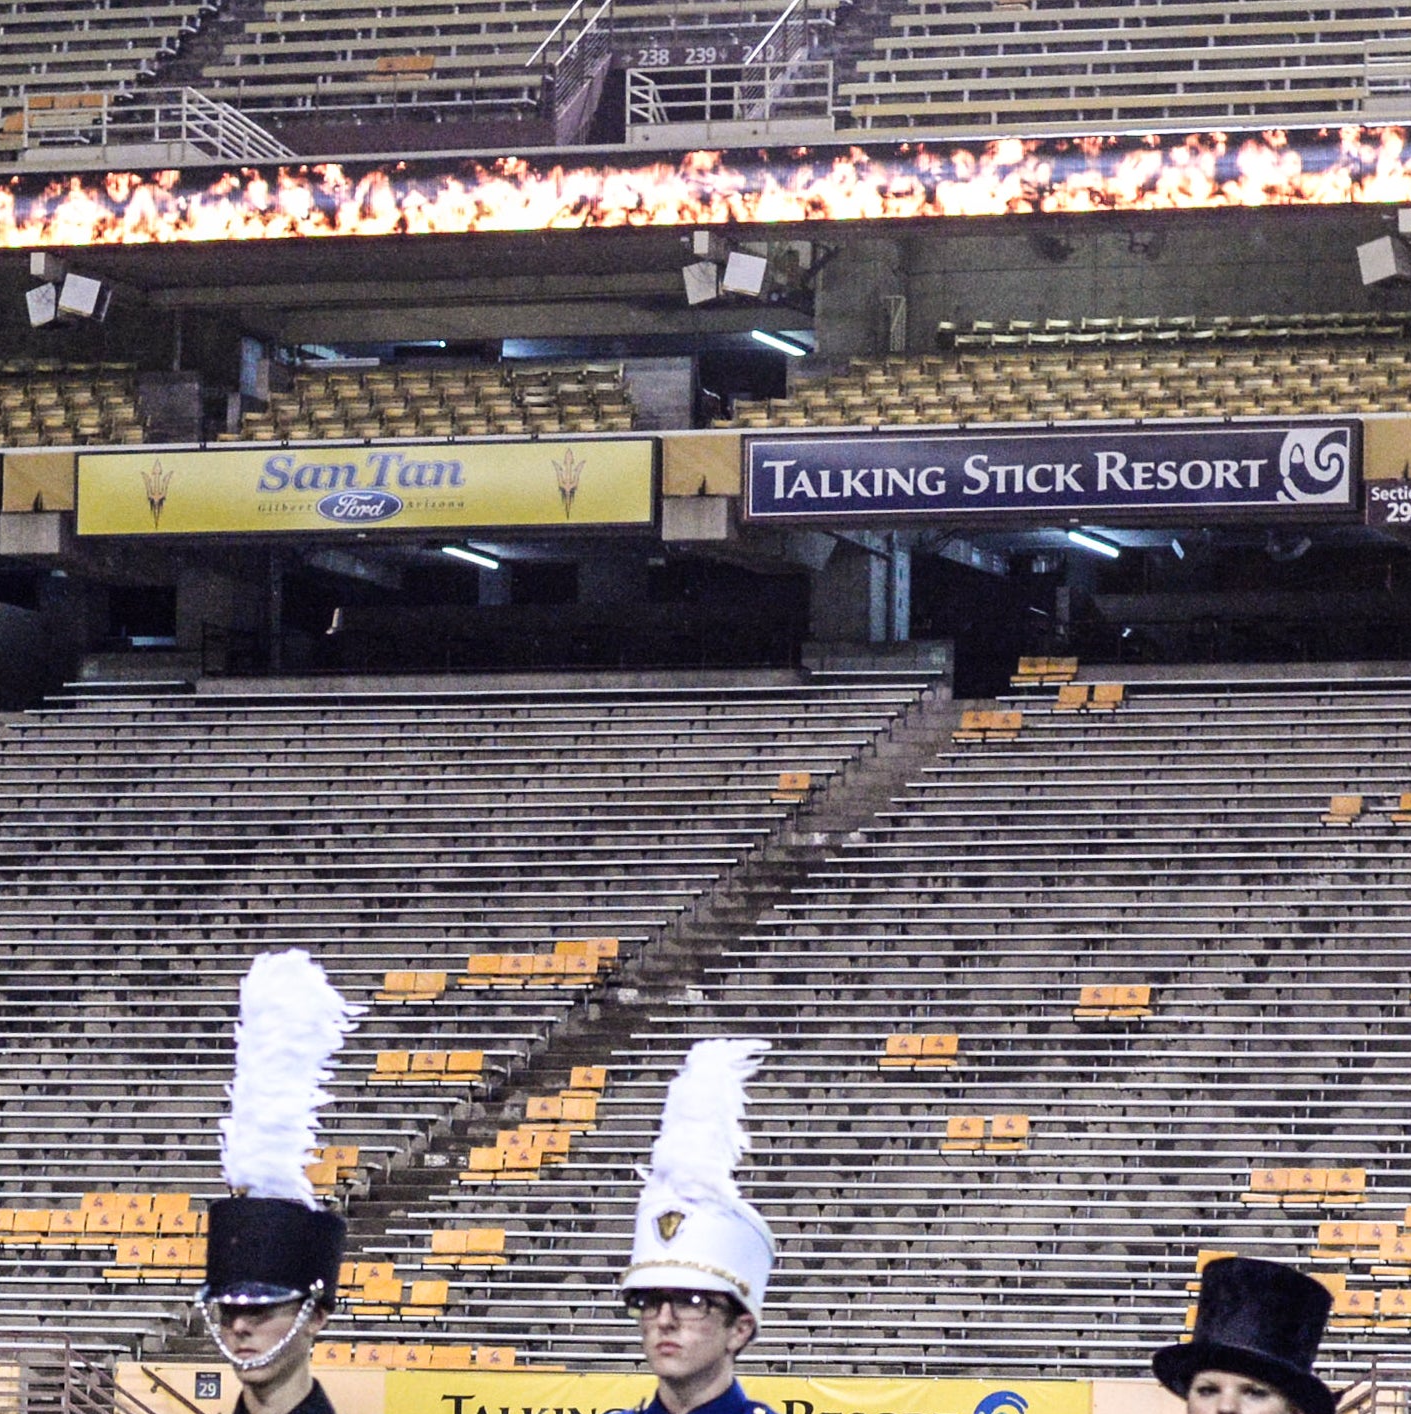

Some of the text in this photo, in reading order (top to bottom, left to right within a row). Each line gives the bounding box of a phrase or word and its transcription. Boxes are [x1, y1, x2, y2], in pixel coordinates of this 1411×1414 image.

[638, 50, 669, 66] 238
[685, 47, 716, 64] 239
[257, 452, 465, 493] San Tan
[762, 451, 1268, 499] TALKING STICK RESORT
[332, 493, 386, 518] Ford
[198, 1382, 217, 1397] 29
